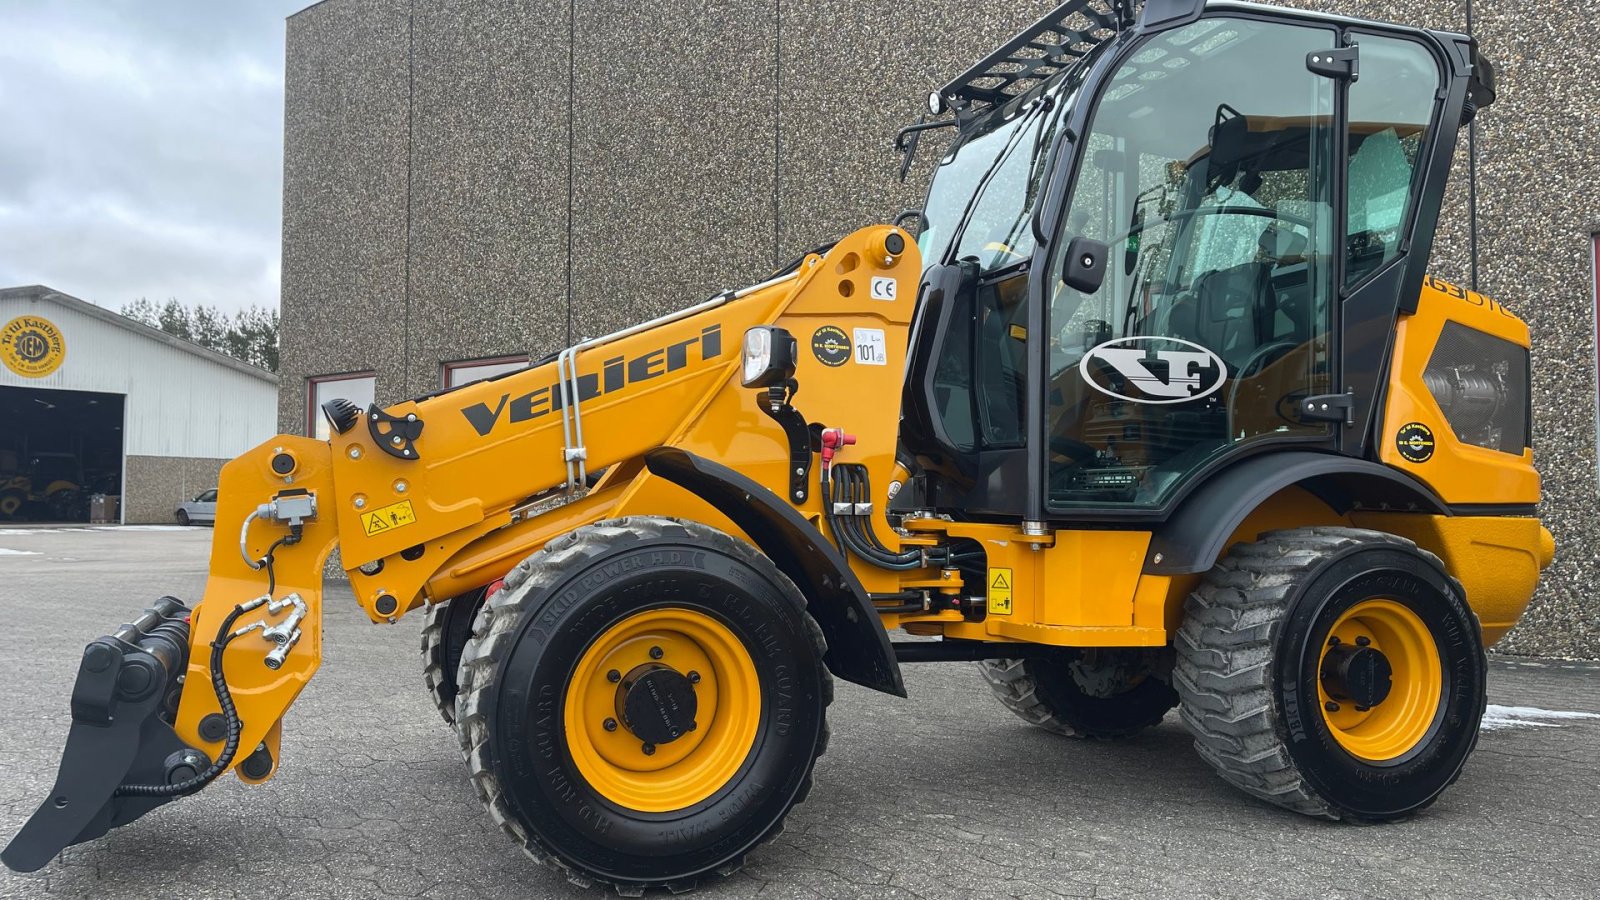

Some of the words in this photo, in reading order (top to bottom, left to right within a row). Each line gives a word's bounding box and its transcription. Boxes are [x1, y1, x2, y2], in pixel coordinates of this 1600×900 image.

[874, 280, 894, 297] CE
[857, 344, 875, 361] 101
[543, 590, 578, 627] SKID
[581, 555, 642, 592] POWER
